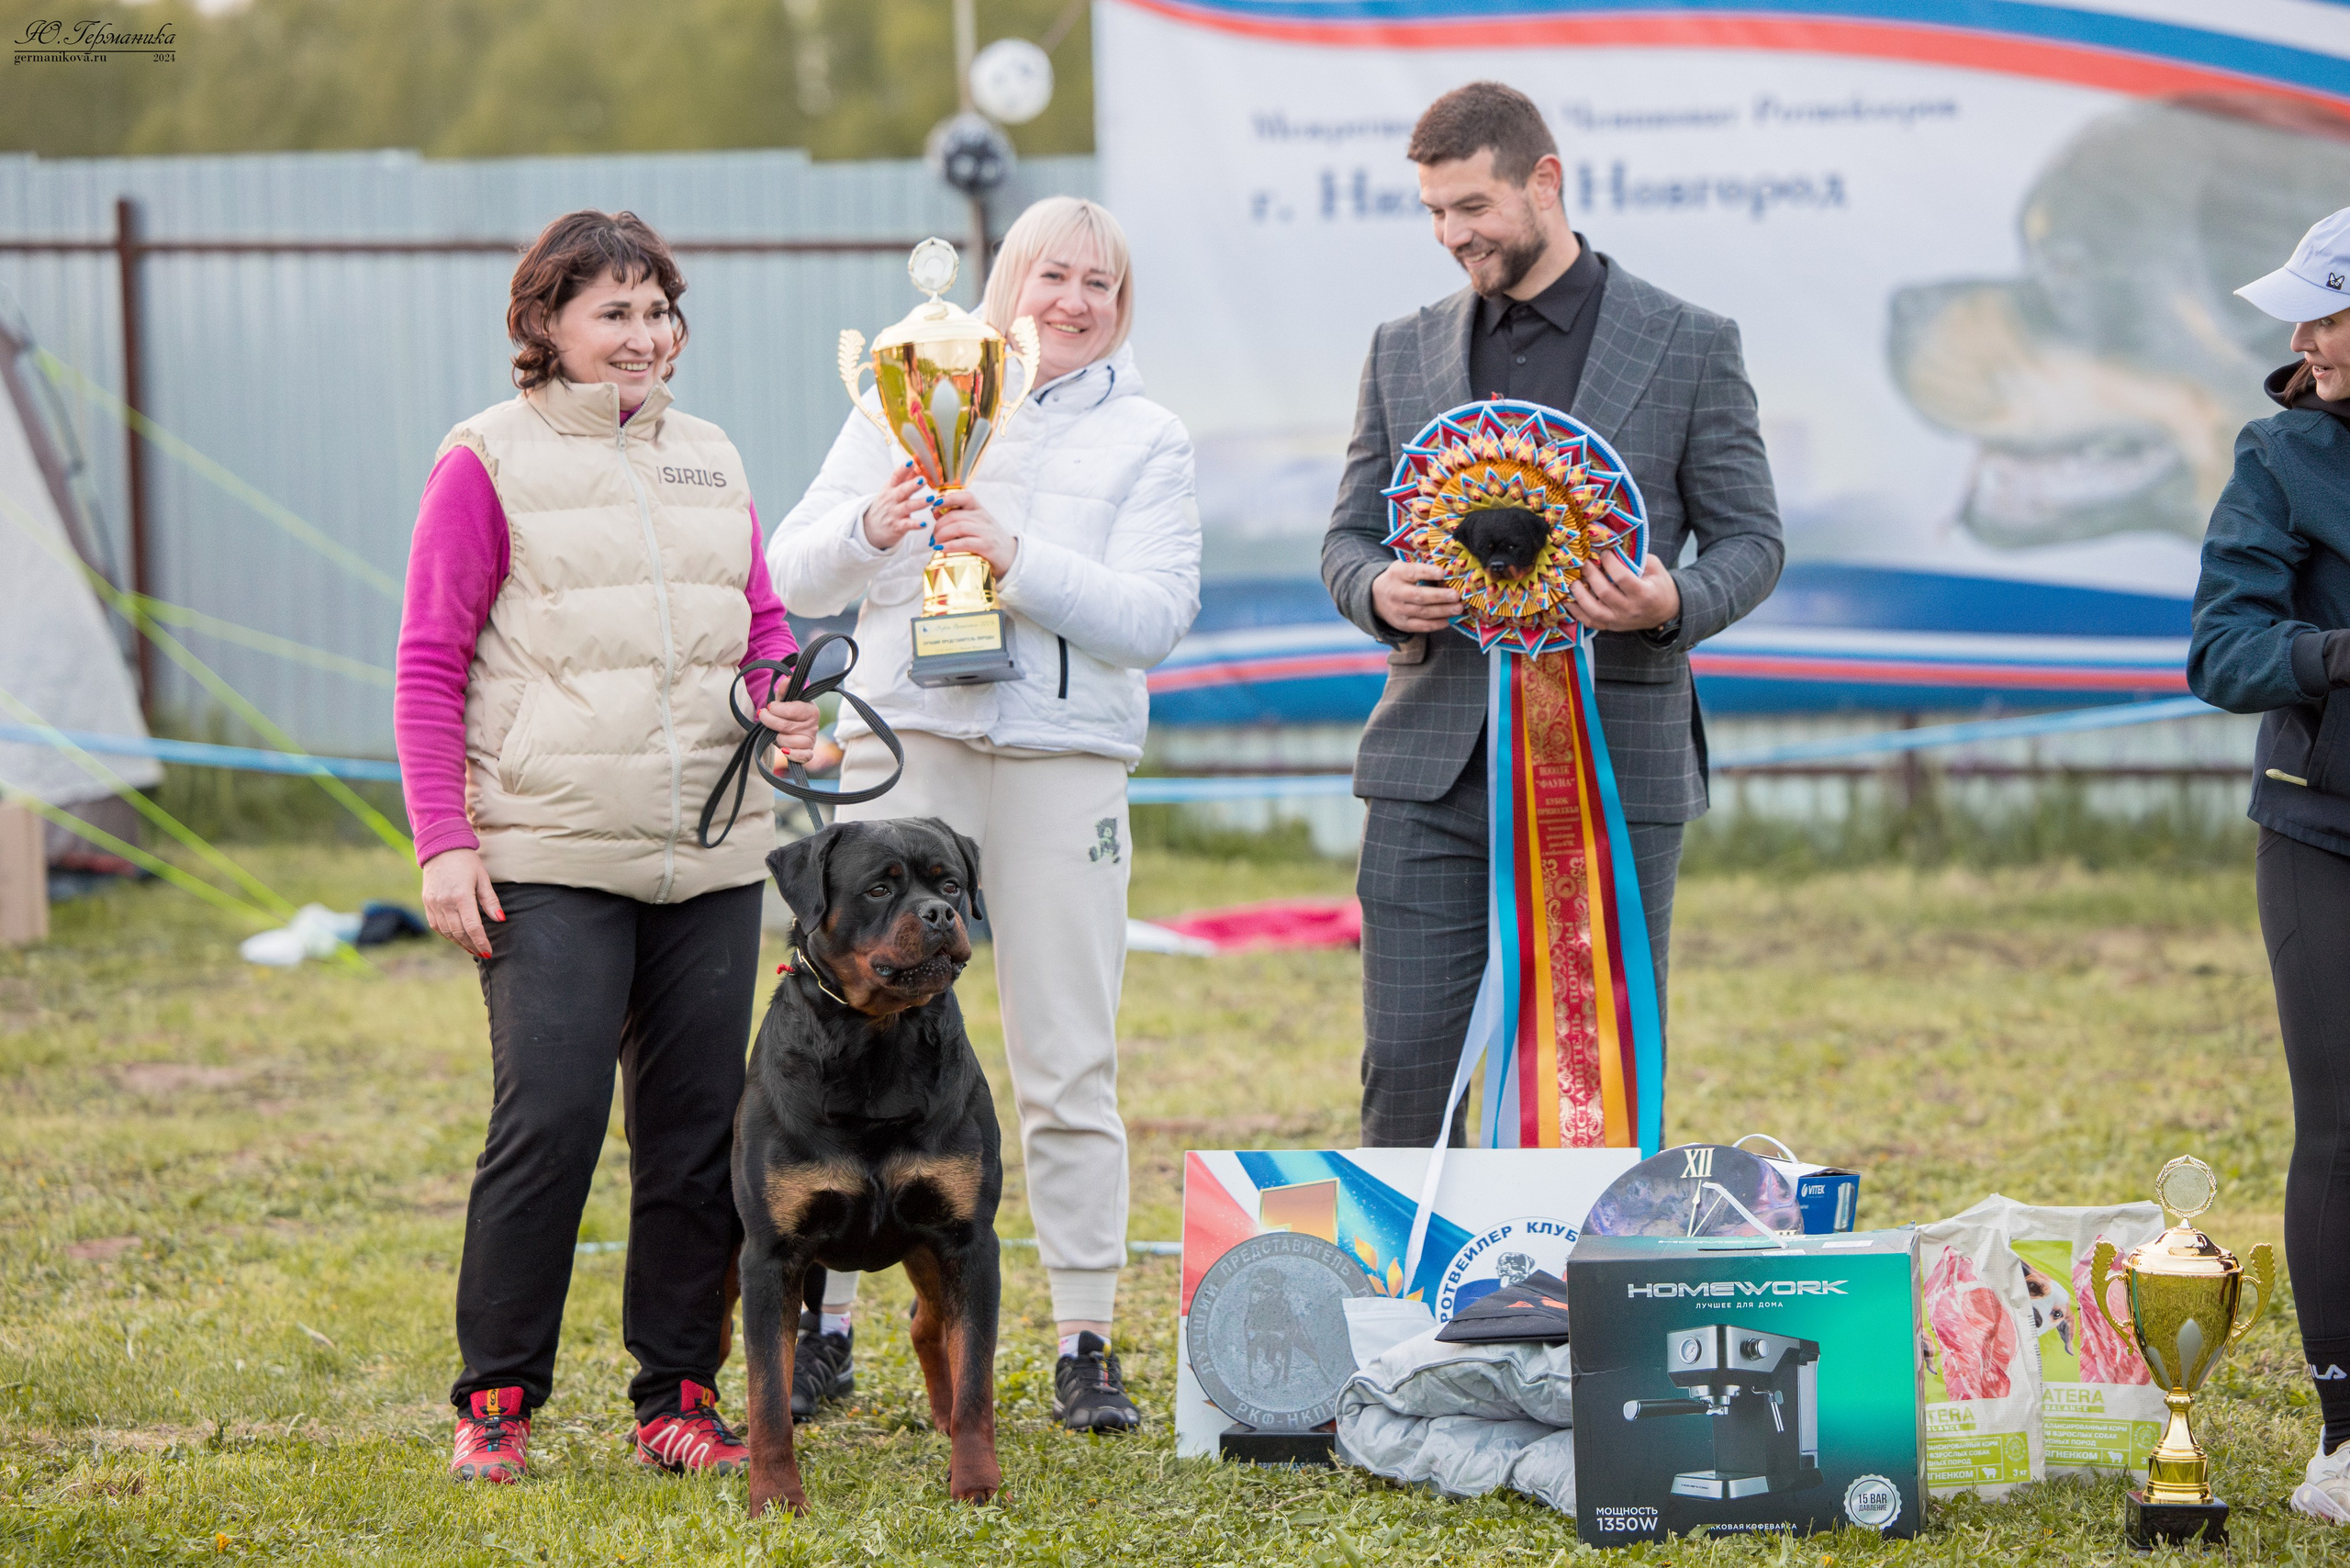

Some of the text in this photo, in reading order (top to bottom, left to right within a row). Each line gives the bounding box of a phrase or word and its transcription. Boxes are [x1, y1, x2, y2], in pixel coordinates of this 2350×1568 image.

[1808, 1184, 1825, 1194] VITEK
[1220, 1238, 1351, 1277] ПРЕДСТАВИТЕЛЬ
[1440, 1222, 1578, 1323] РОТВЕЙЛЕР КЛУБ
[1628, 1280, 1850, 1299] HOMEWORK
[1758, 1301, 1784, 1309] ДОМА
[1859, 1493, 1887, 1505] 15 BAR
[1595, 1506, 1658, 1517] МОЩНОСТЬ
[1859, 1504, 1887, 1512] ДАВЛЕНИЕ
[1596, 1517, 1659, 1532] 1350W
